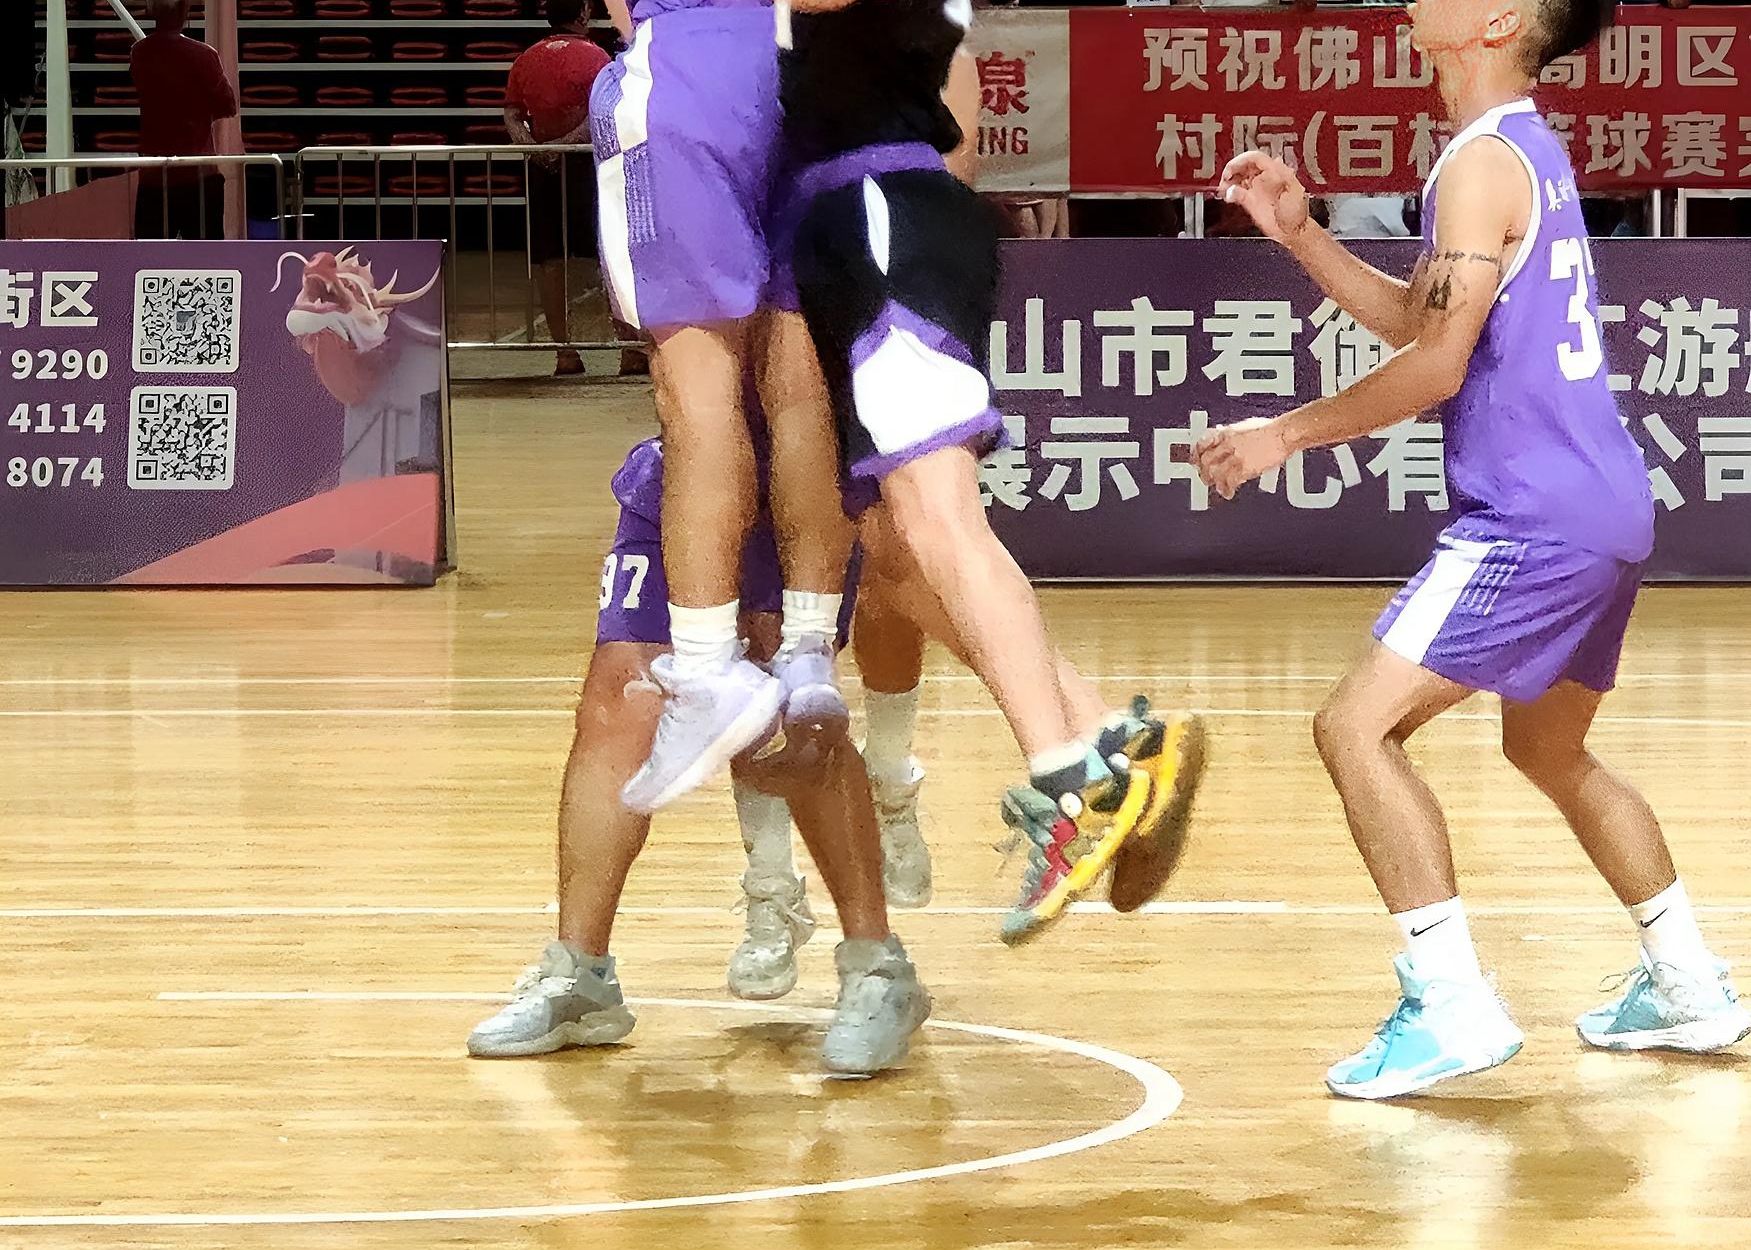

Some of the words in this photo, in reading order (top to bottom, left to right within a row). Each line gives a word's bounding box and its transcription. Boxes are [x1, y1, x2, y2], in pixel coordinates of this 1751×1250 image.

[1550, 236, 1603, 382] 3
[11, 349, 109, 380] 9290
[7, 403, 107, 434] 4114
[6, 456, 105, 488] 8074
